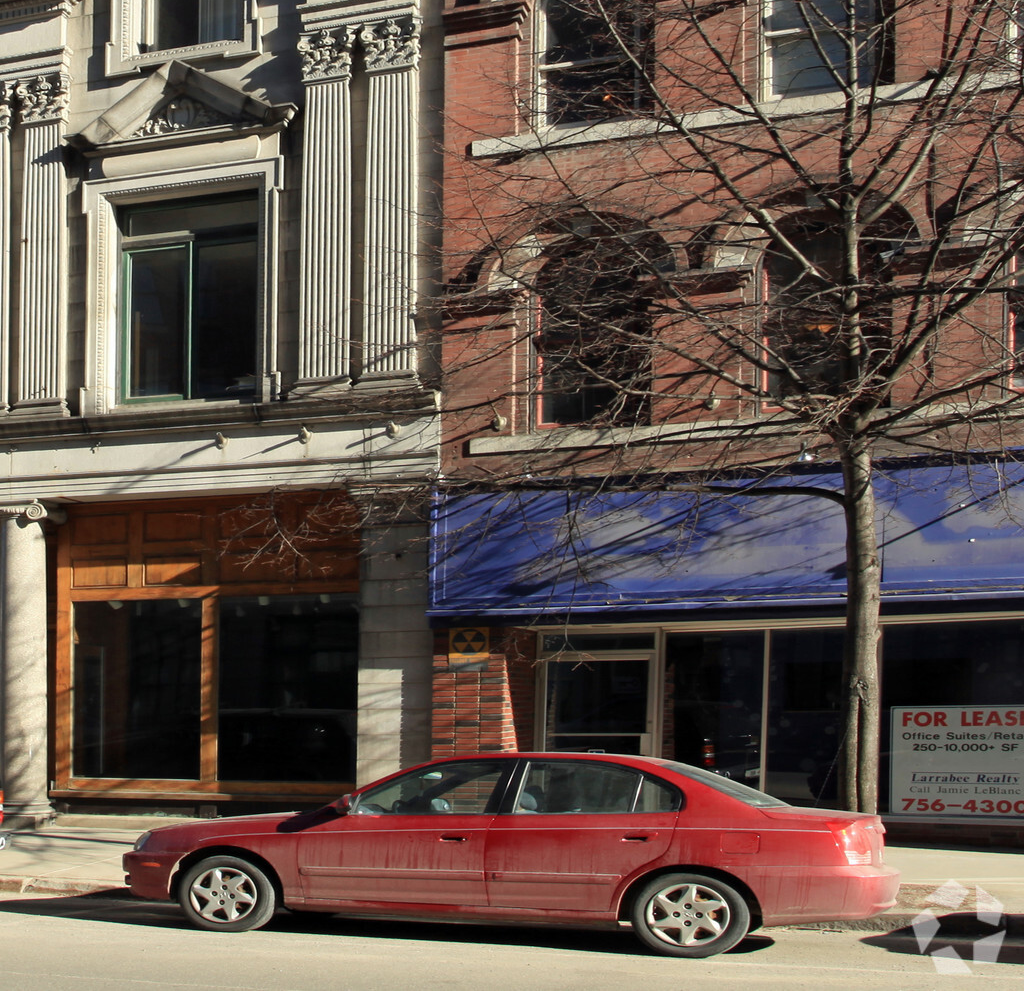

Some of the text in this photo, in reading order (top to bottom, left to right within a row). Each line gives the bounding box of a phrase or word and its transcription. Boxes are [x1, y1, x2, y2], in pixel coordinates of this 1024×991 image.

[902, 711, 948, 727] FOR
[902, 731, 940, 741] Office
[912, 743, 1019, 752] 250-10,000+ SF
[911, 773, 1021, 785] Larrabee Realty
[909, 785, 1021, 795] Call Jamie LeBlanc
